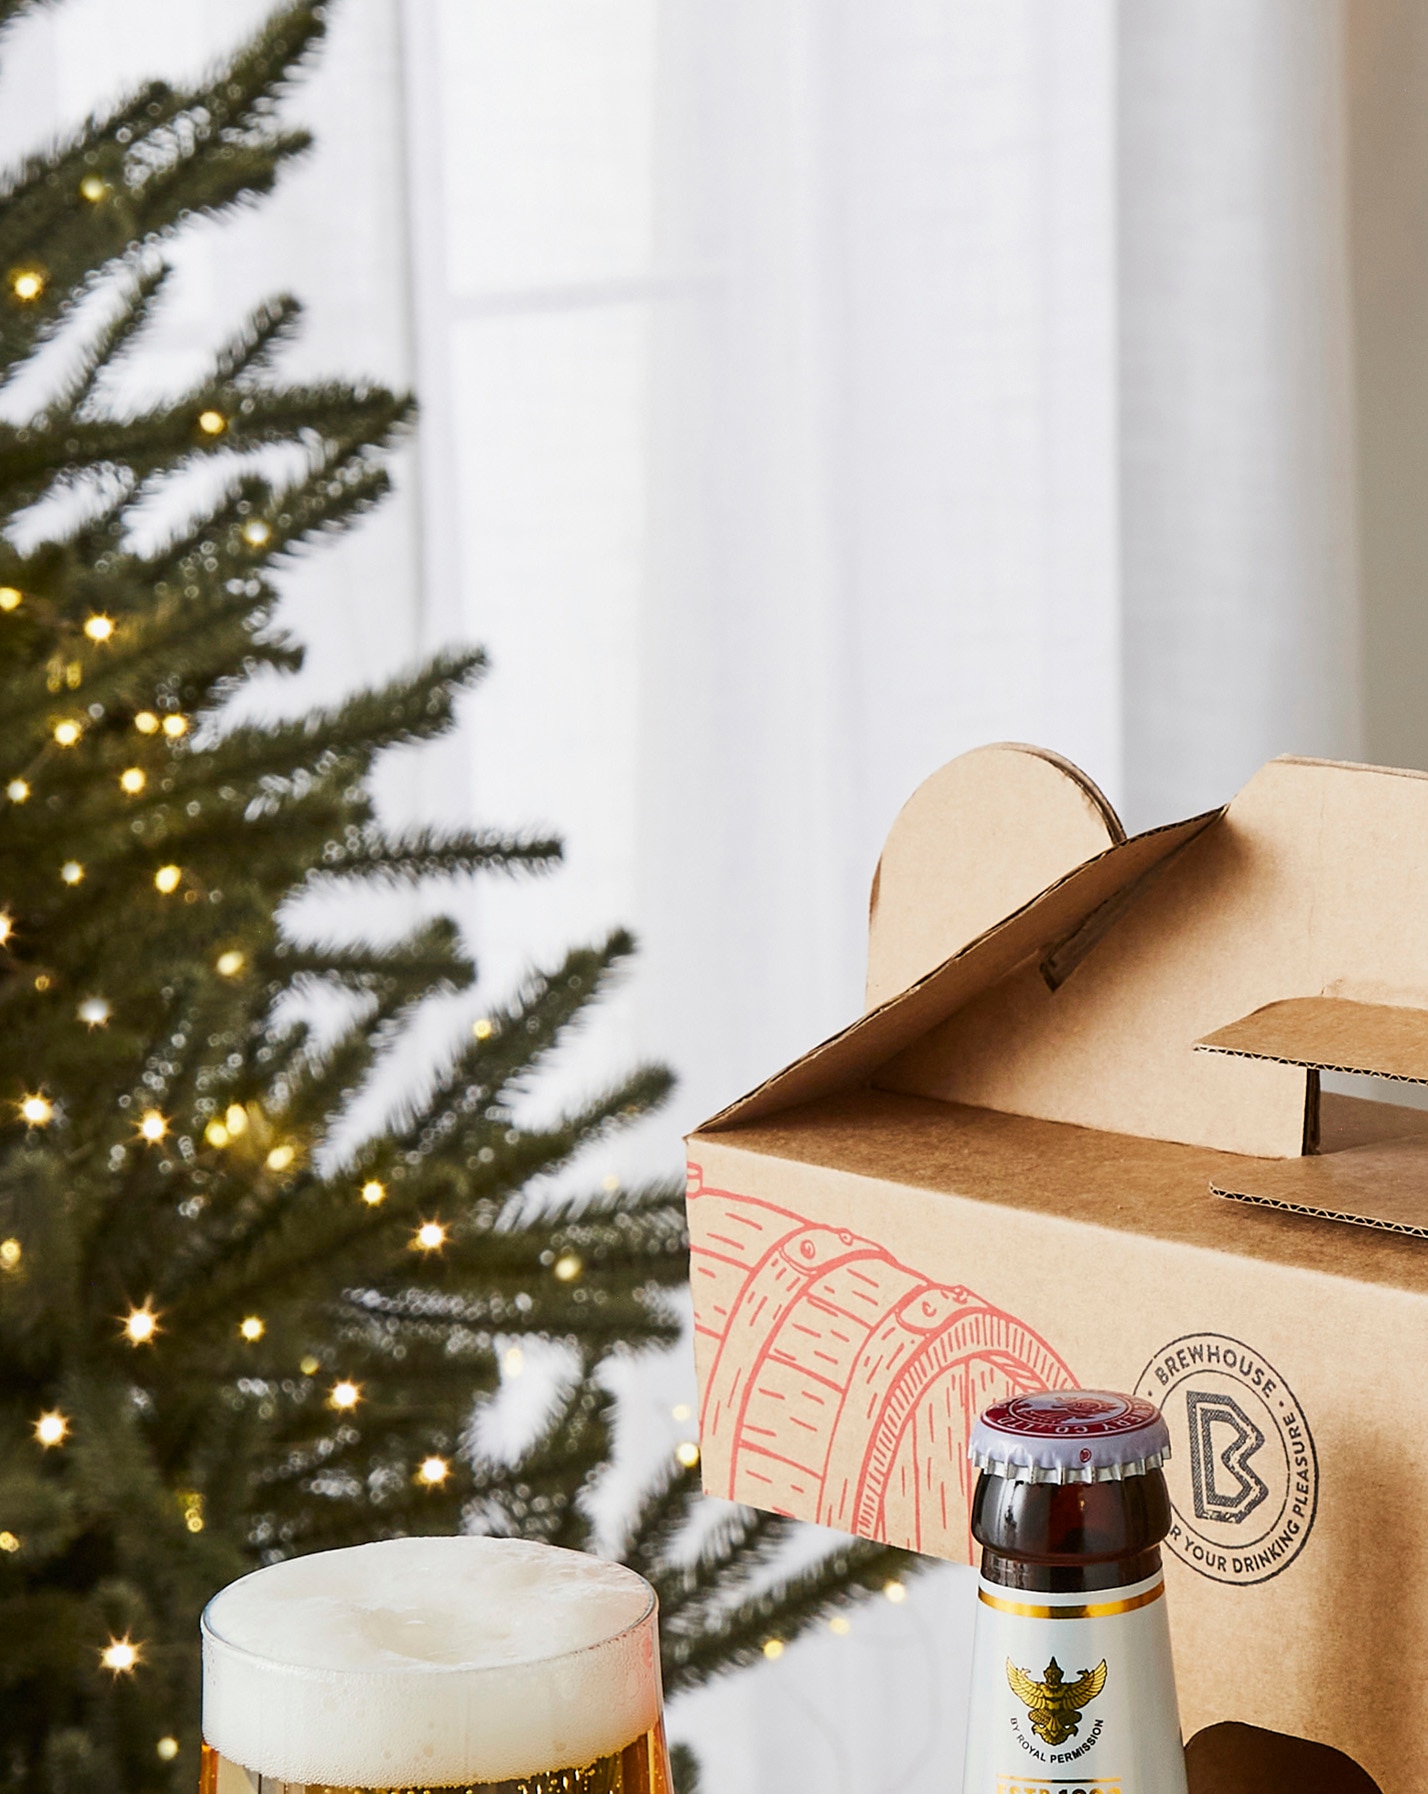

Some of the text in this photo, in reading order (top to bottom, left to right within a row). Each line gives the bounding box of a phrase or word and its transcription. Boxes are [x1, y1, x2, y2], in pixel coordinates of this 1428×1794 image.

[1154, 1344, 1277, 1399] BREWHOUSE
[1184, 1412, 1310, 1574] YOUR DRINKING PLEASURE
[1009, 1717, 1104, 1764] BY ROYAL PERMISSION
